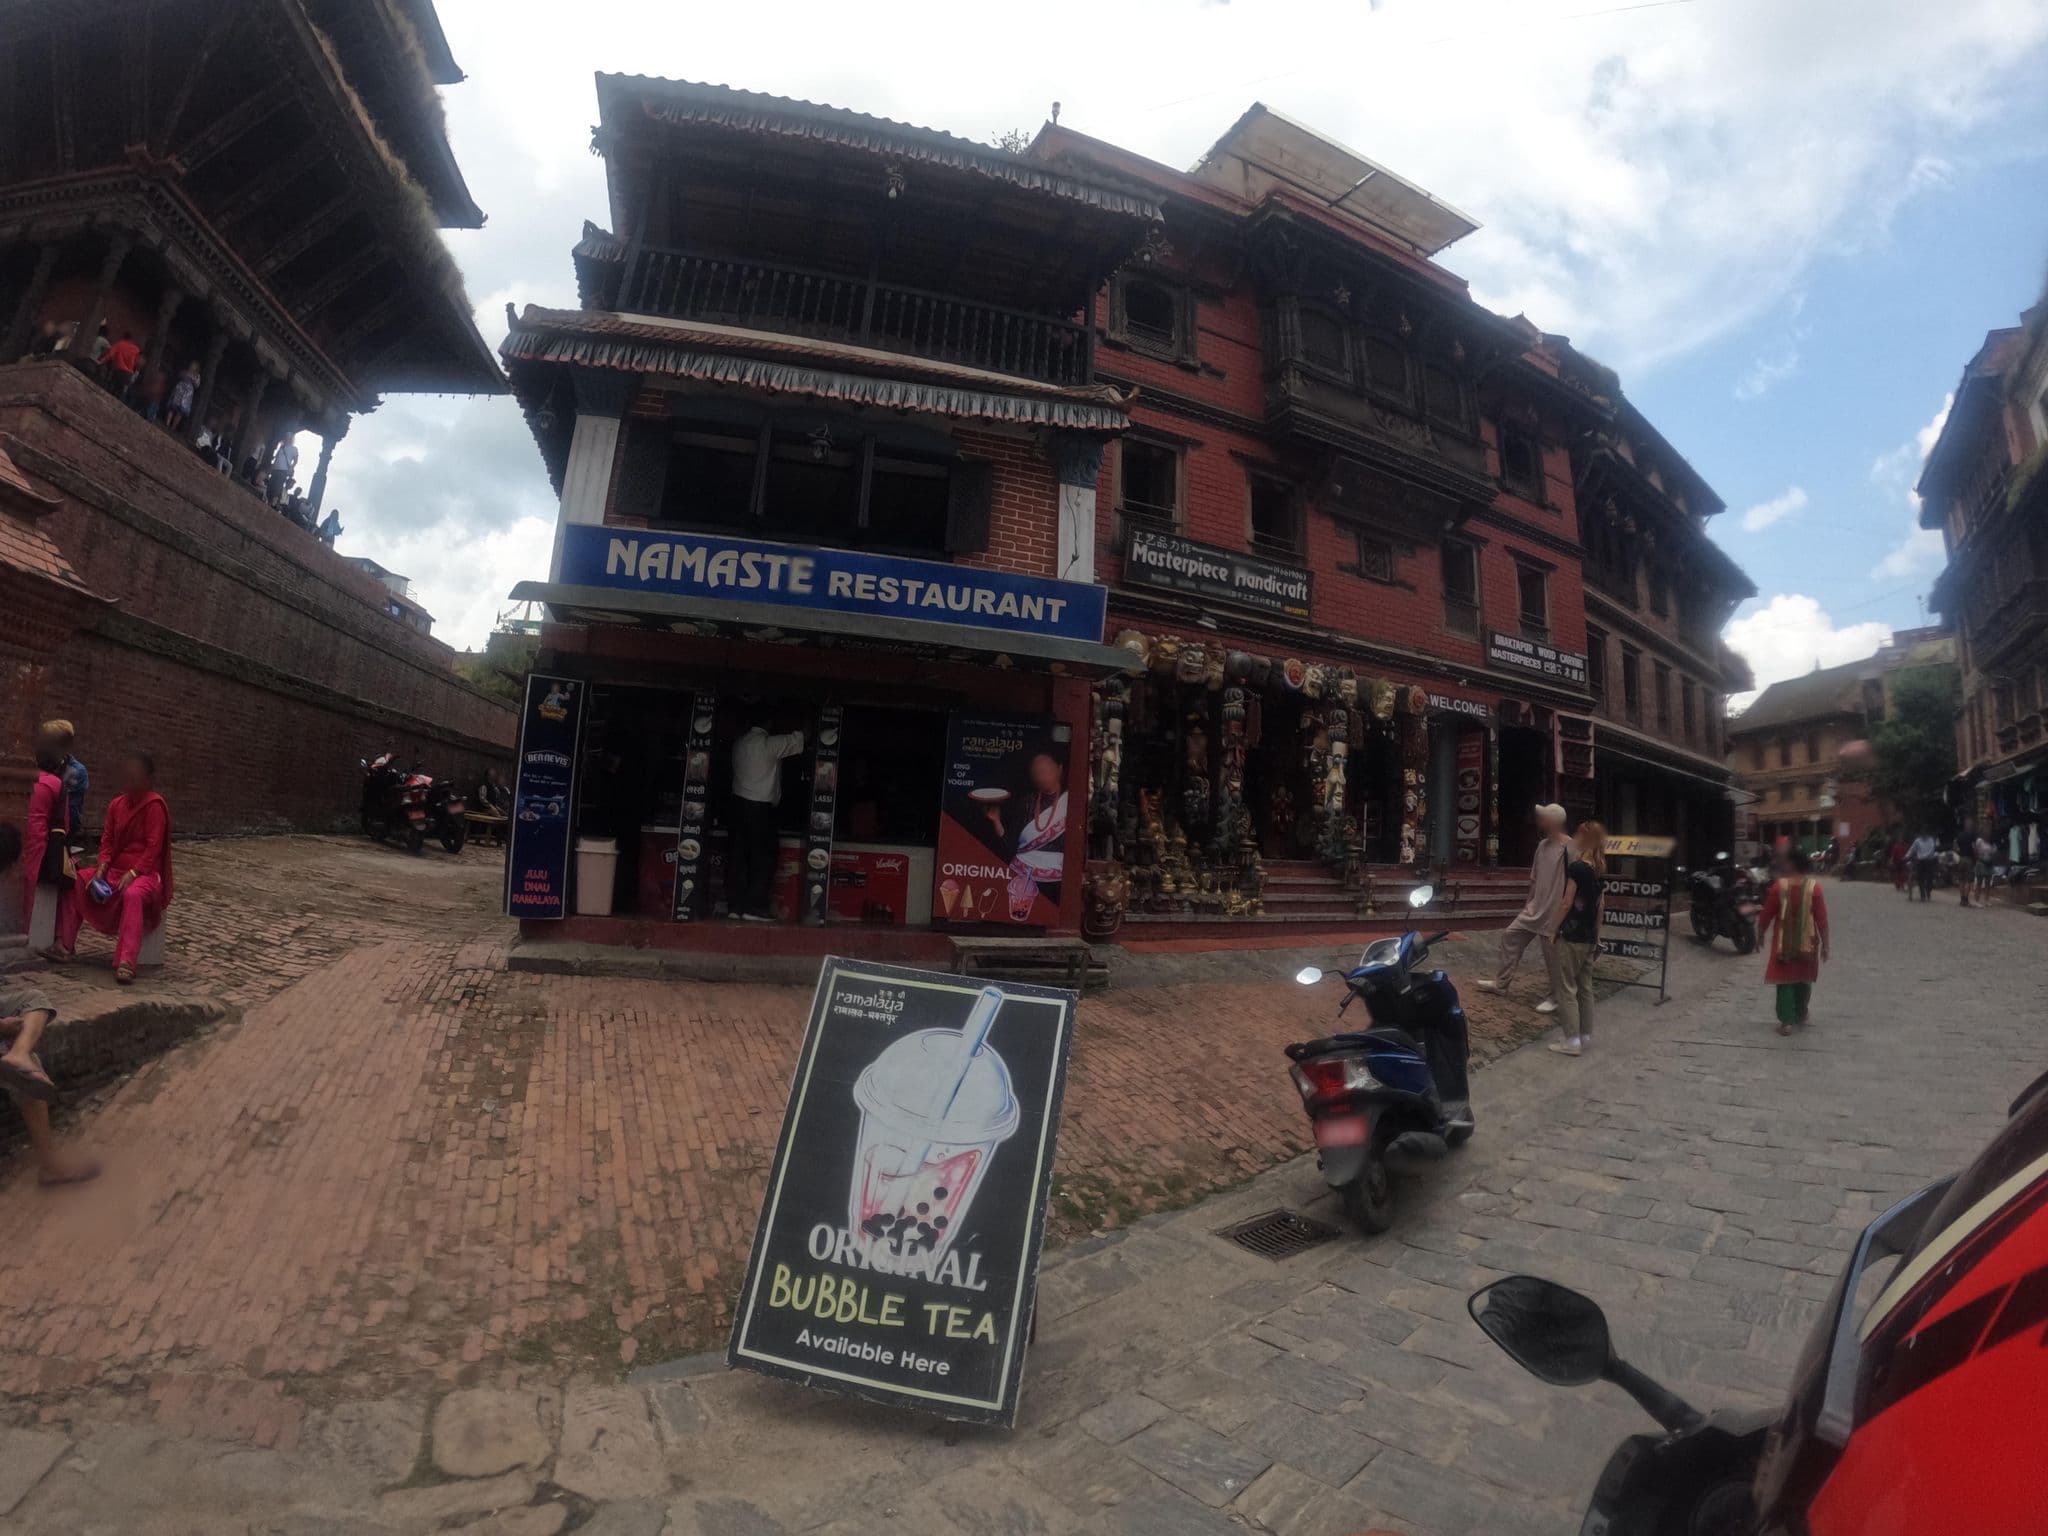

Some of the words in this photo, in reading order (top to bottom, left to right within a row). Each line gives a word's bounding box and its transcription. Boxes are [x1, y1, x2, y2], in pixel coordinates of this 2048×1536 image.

[606, 538, 814, 592] NAMASTE
[828, 571, 1067, 623] RESTAURANT
[1132, 542, 1229, 582] Masterpiece
[1234, 567, 1308, 601] Handicraft
[1491, 647, 1541, 670] MASTERPIECES
[1537, 646, 1556, 660] WOOD
[1430, 694, 1487, 717] WELCOME
[948, 779, 975, 787] YOGURT
[957, 770, 966, 778] OF
[942, 863, 1012, 880] ORIGINAL
[512, 894, 560, 905] RAMALAYA
[835, 991, 904, 1014] ramalaya
[808, 1224, 987, 1292] ORIGINAL
[769, 1264, 905, 1328] BUBBLE
[923, 1303, 994, 1345] TEA
[795, 1329, 895, 1366] Available
[900, 1351, 950, 1376] Here
